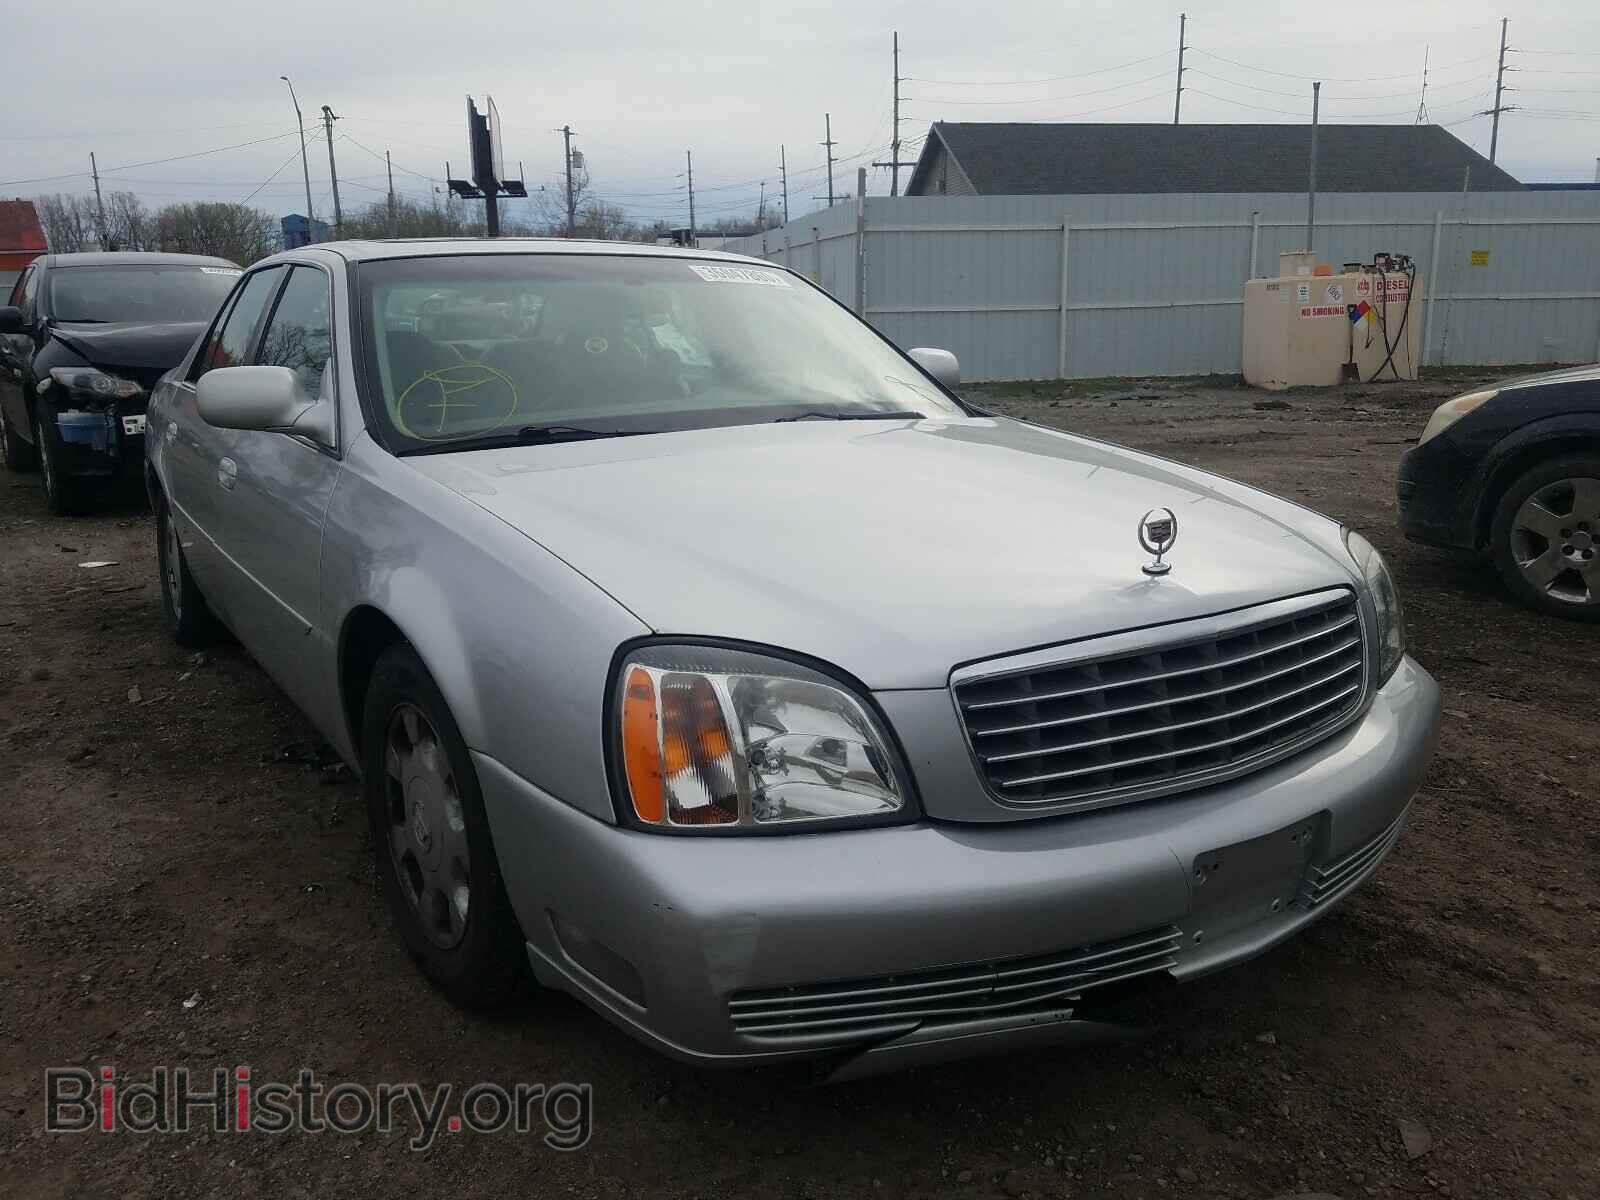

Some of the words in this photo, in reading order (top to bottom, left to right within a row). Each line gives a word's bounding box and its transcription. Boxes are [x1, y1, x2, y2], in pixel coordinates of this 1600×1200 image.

[1376, 279, 1409, 291] DIESEL
[1301, 307, 1311, 317] NO
[1312, 306, 1345, 316] SMOKING
